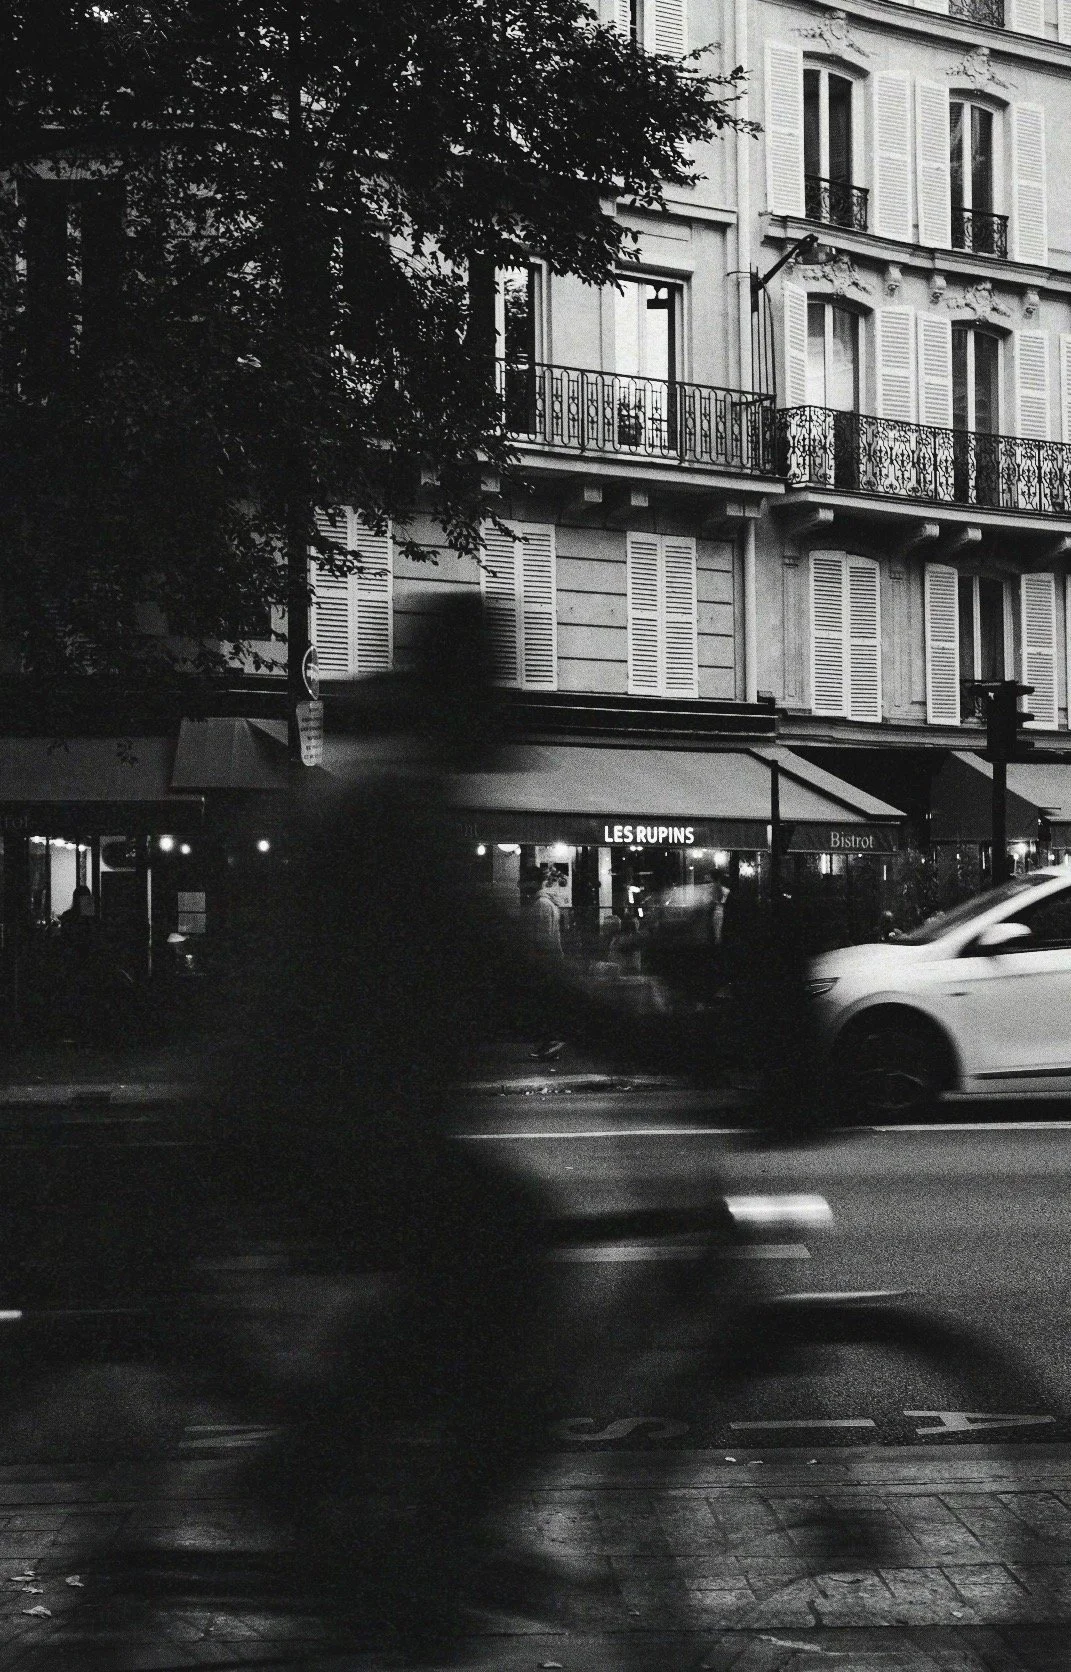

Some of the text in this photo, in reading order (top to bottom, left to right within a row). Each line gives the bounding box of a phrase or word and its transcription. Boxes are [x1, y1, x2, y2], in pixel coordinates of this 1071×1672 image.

[604, 825, 695, 844] LES RUPINS
[830, 831, 875, 849] Bistrot
